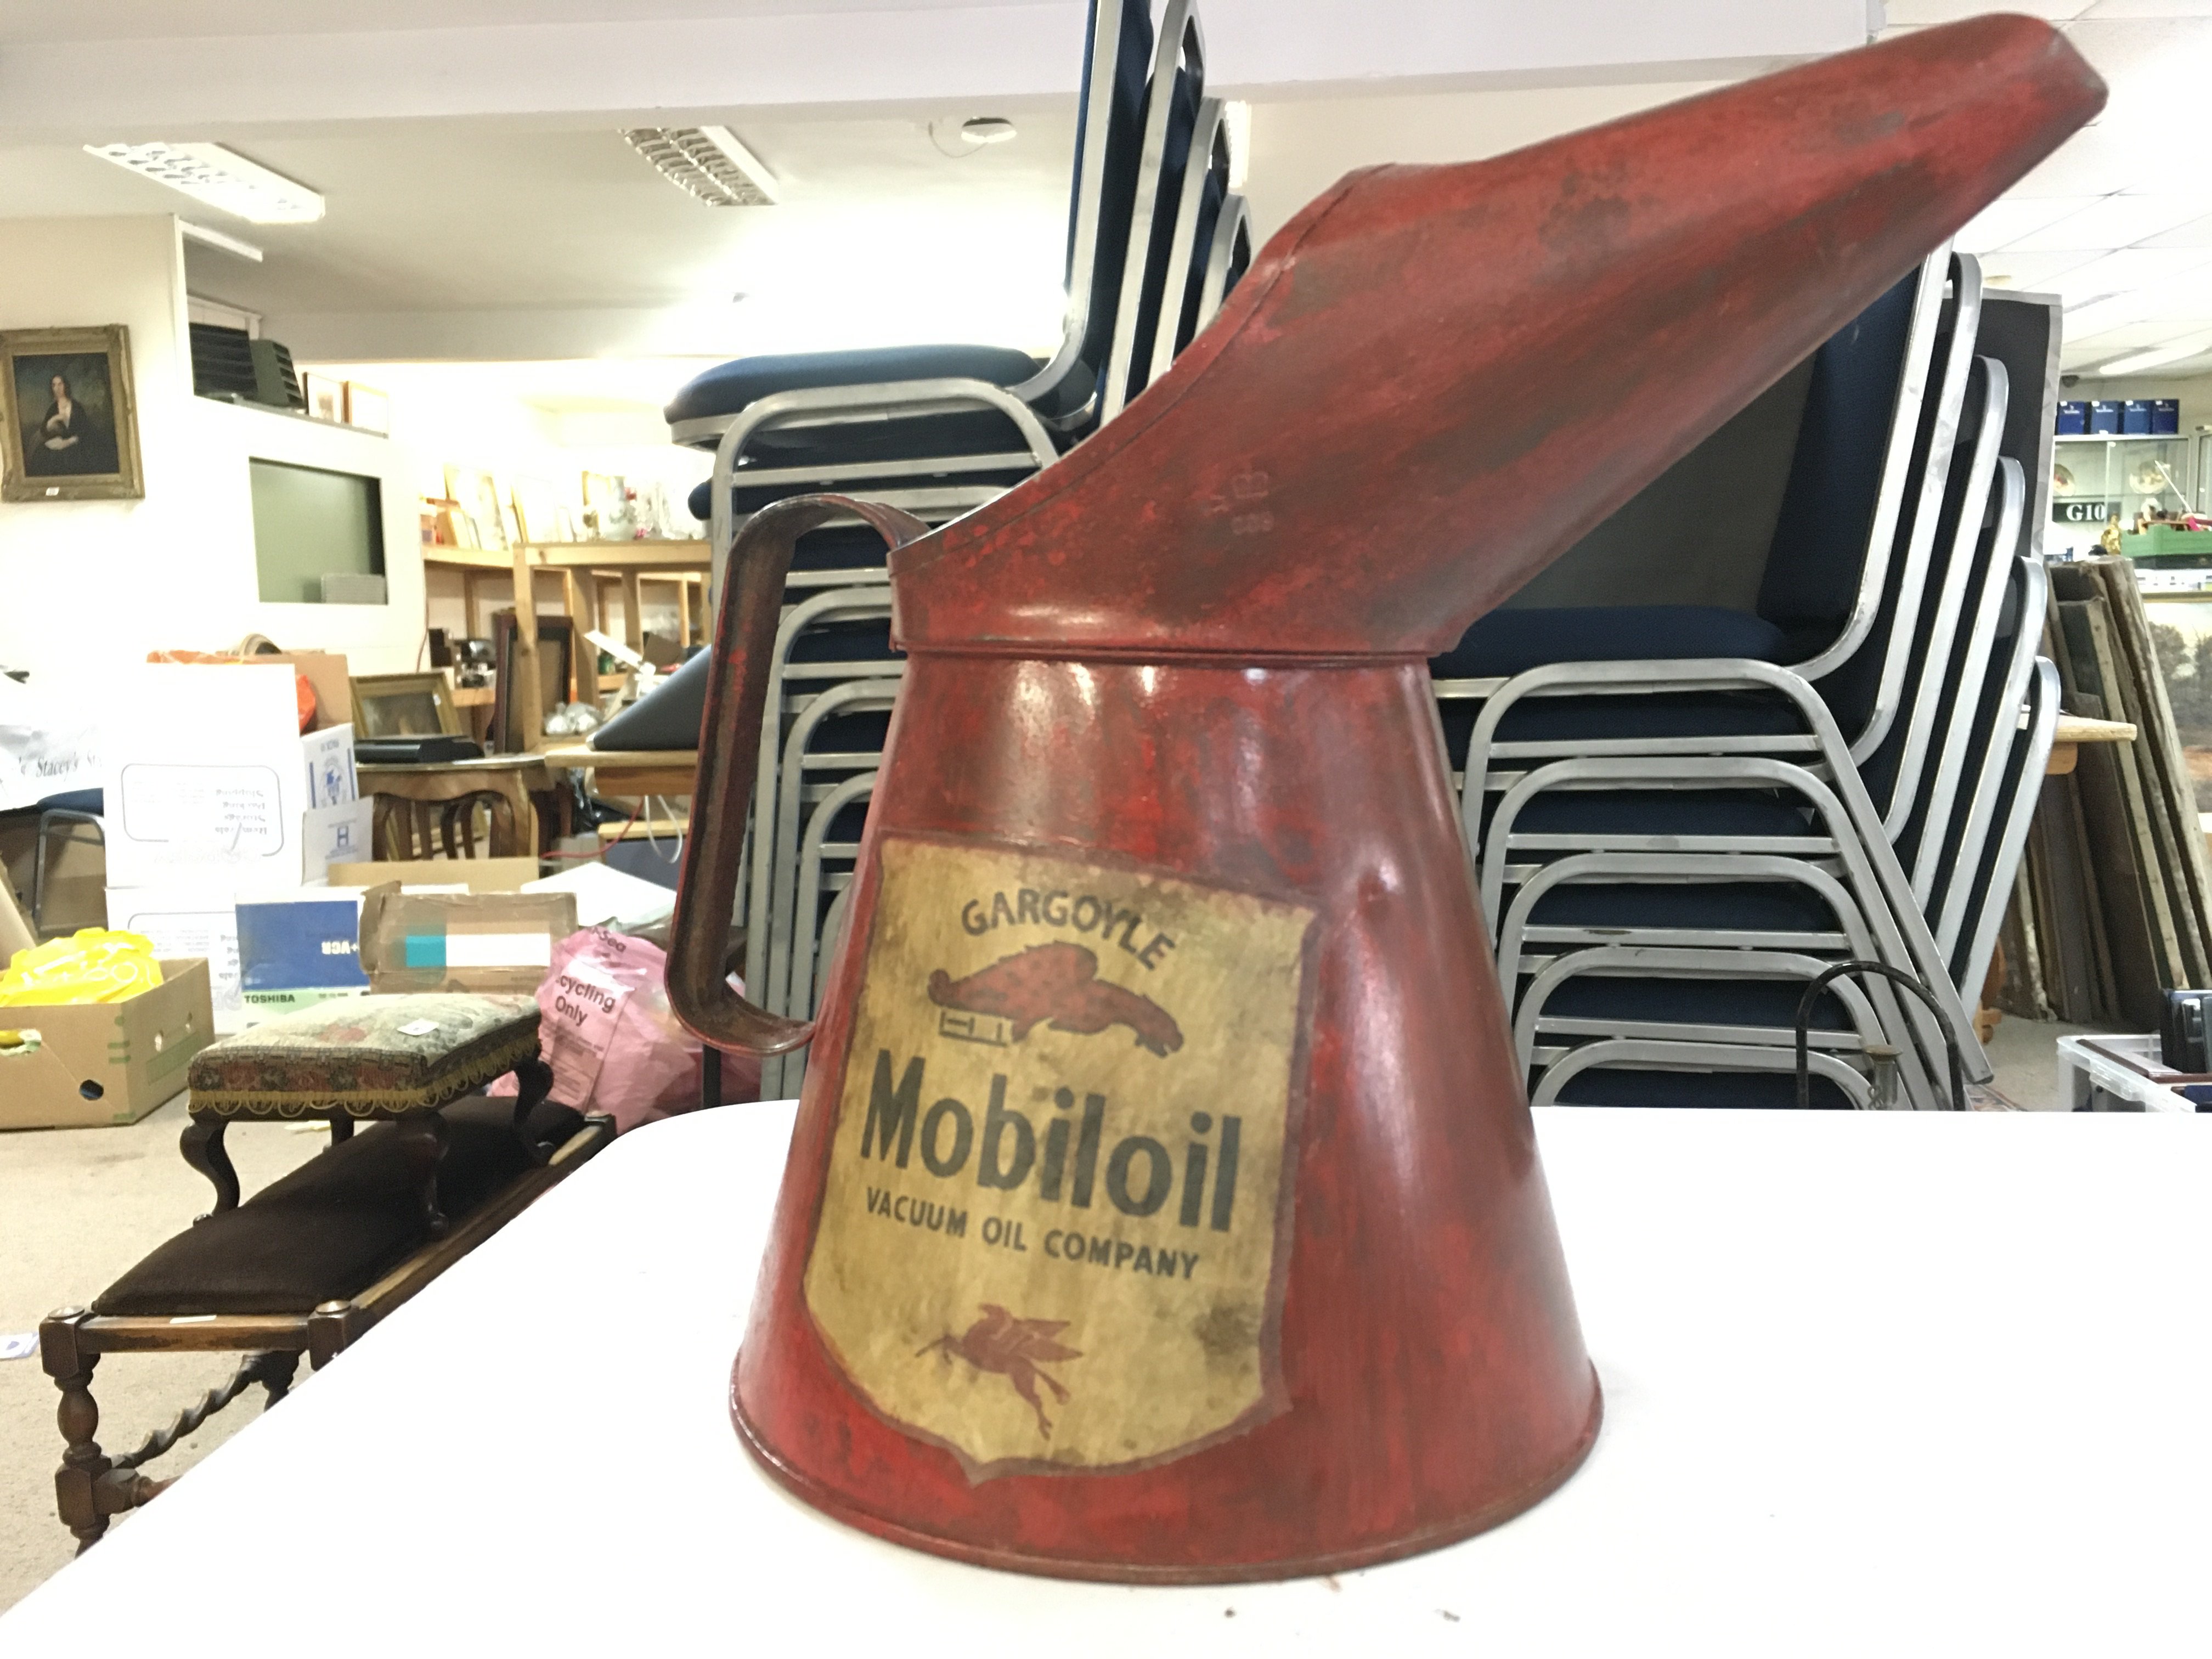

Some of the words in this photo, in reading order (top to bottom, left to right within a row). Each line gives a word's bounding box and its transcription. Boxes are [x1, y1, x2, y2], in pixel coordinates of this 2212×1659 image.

[36, 751, 78, 782] Stacey's
[961, 889, 1176, 970] GARGOYLE
[244, 994, 295, 1003] TOSHIBA
[555, 995, 588, 1026] Only
[556, 975, 616, 1014] cycling
[860, 1048, 1242, 1233] Mobiloil
[867, 1187, 968, 1237] VACUUM
[982, 1217, 1027, 1251] OIL
[1044, 1229, 1200, 1280] COMPANY
